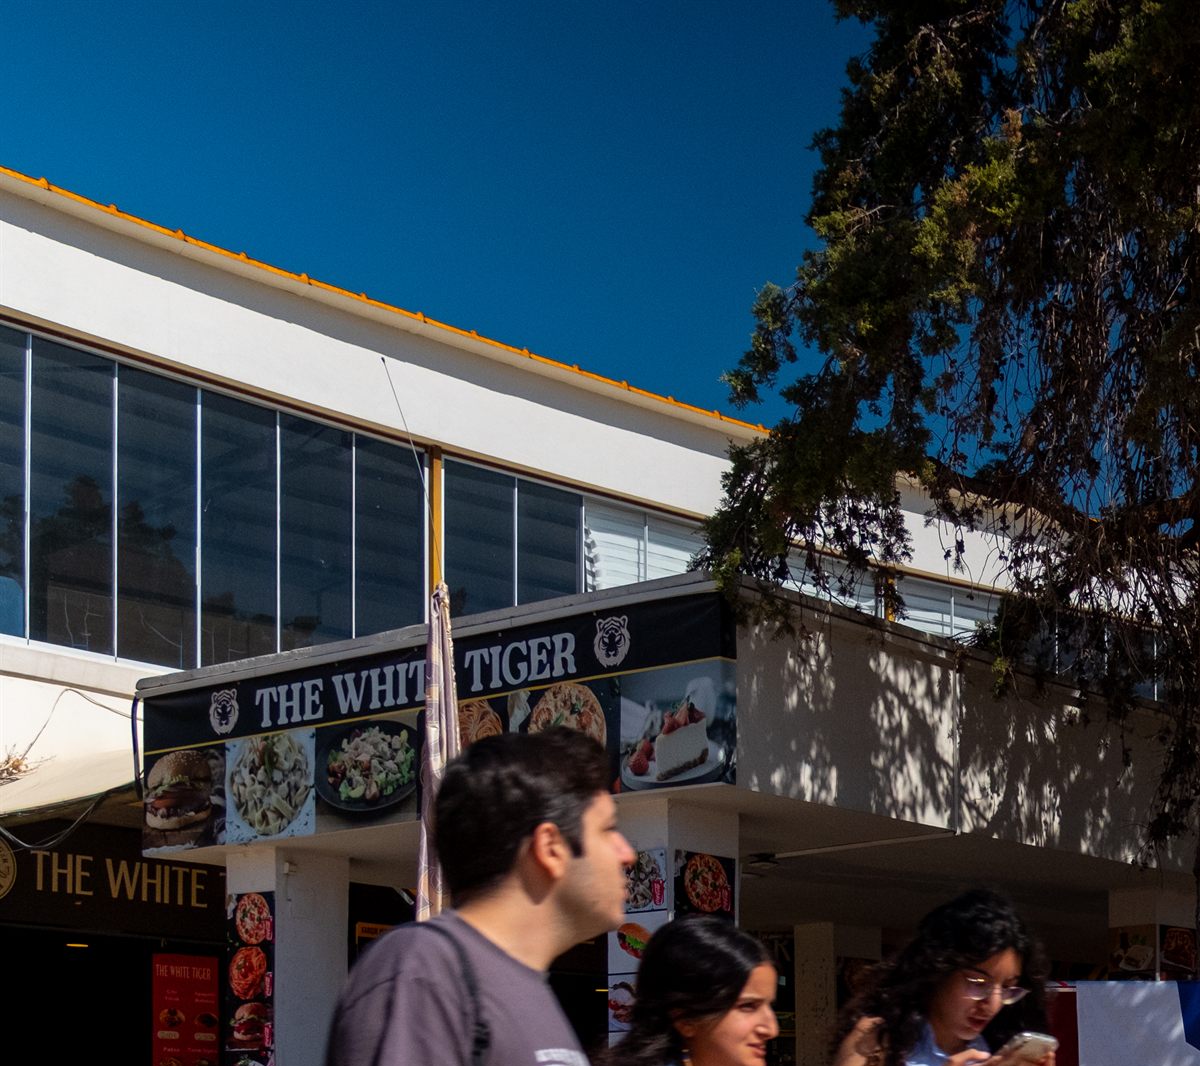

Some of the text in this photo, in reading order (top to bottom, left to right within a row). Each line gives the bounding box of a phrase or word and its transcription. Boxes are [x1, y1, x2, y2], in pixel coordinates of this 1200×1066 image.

[255, 632, 576, 728] THE WHIT TIGER
[30, 850, 94, 896] THE
[105, 858, 208, 908] WHITE
[155, 964, 169, 977] THE
[191, 967, 211, 981] TIGER
